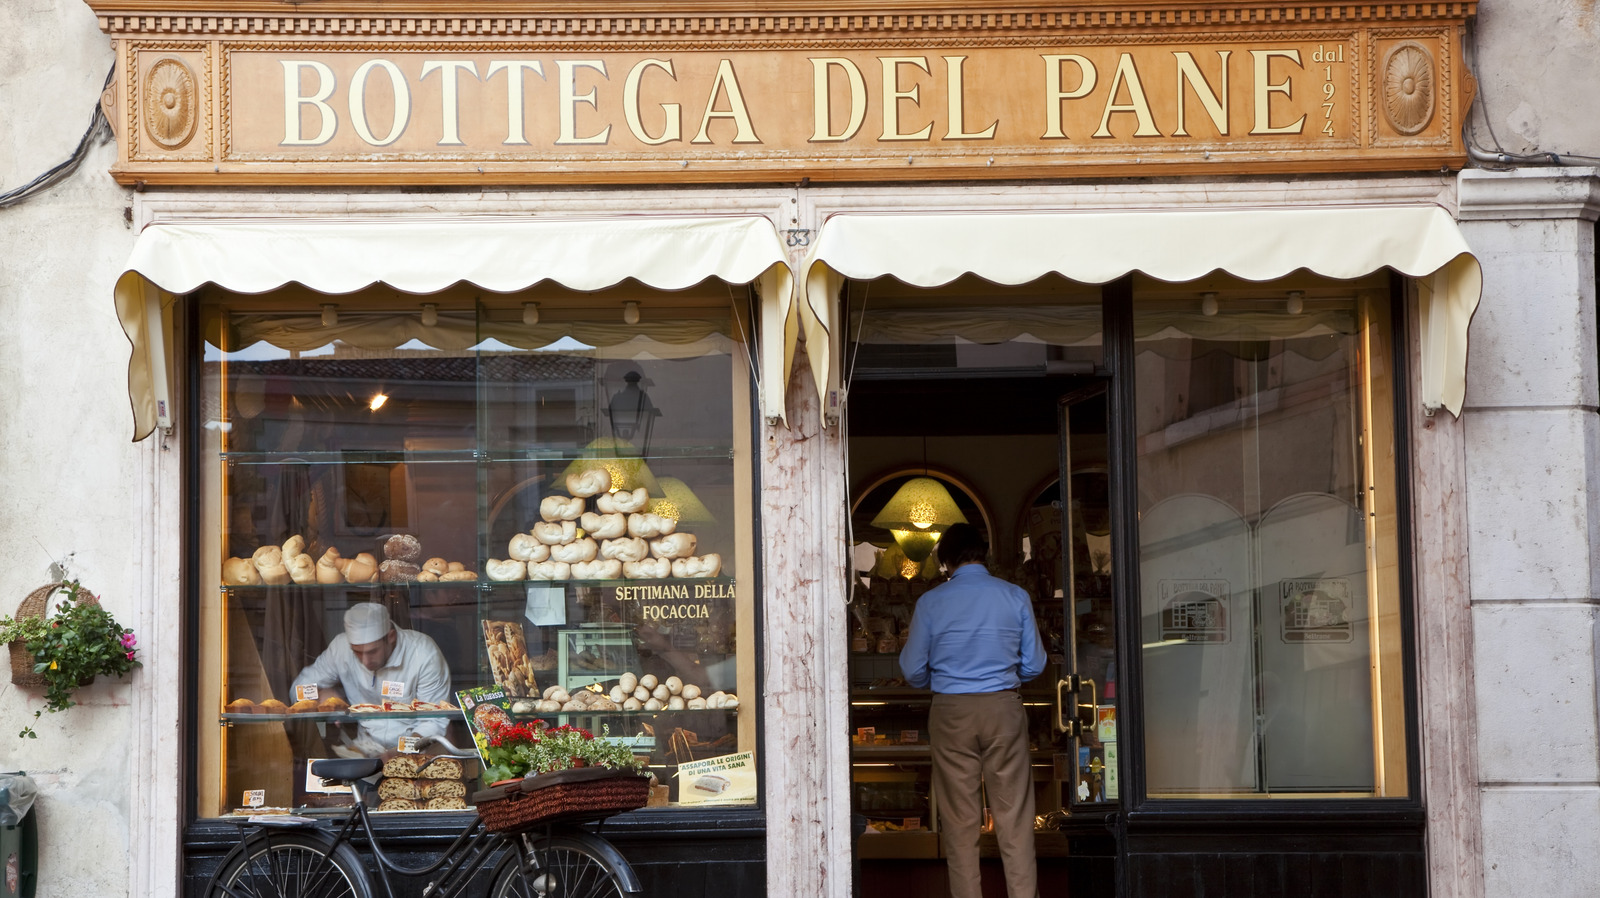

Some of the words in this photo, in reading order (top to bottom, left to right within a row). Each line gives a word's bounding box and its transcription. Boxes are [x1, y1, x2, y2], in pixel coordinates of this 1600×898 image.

[1312, 44, 1345, 63] dal
[278, 58, 764, 146] BOTTEGA
[807, 55, 999, 142] DEL
[1039, 49, 1307, 140] PANE
[1322, 65, 1336, 138] 1974
[786, 229, 810, 246] 33
[615, 585, 690, 601] SETTIMANA
[694, 584, 736, 599] DELLA
[642, 604, 710, 621] FOCACCIA
[475, 694, 484, 703] La
[697, 767, 711, 775] UNA
[728, 761, 746, 770] SANA
